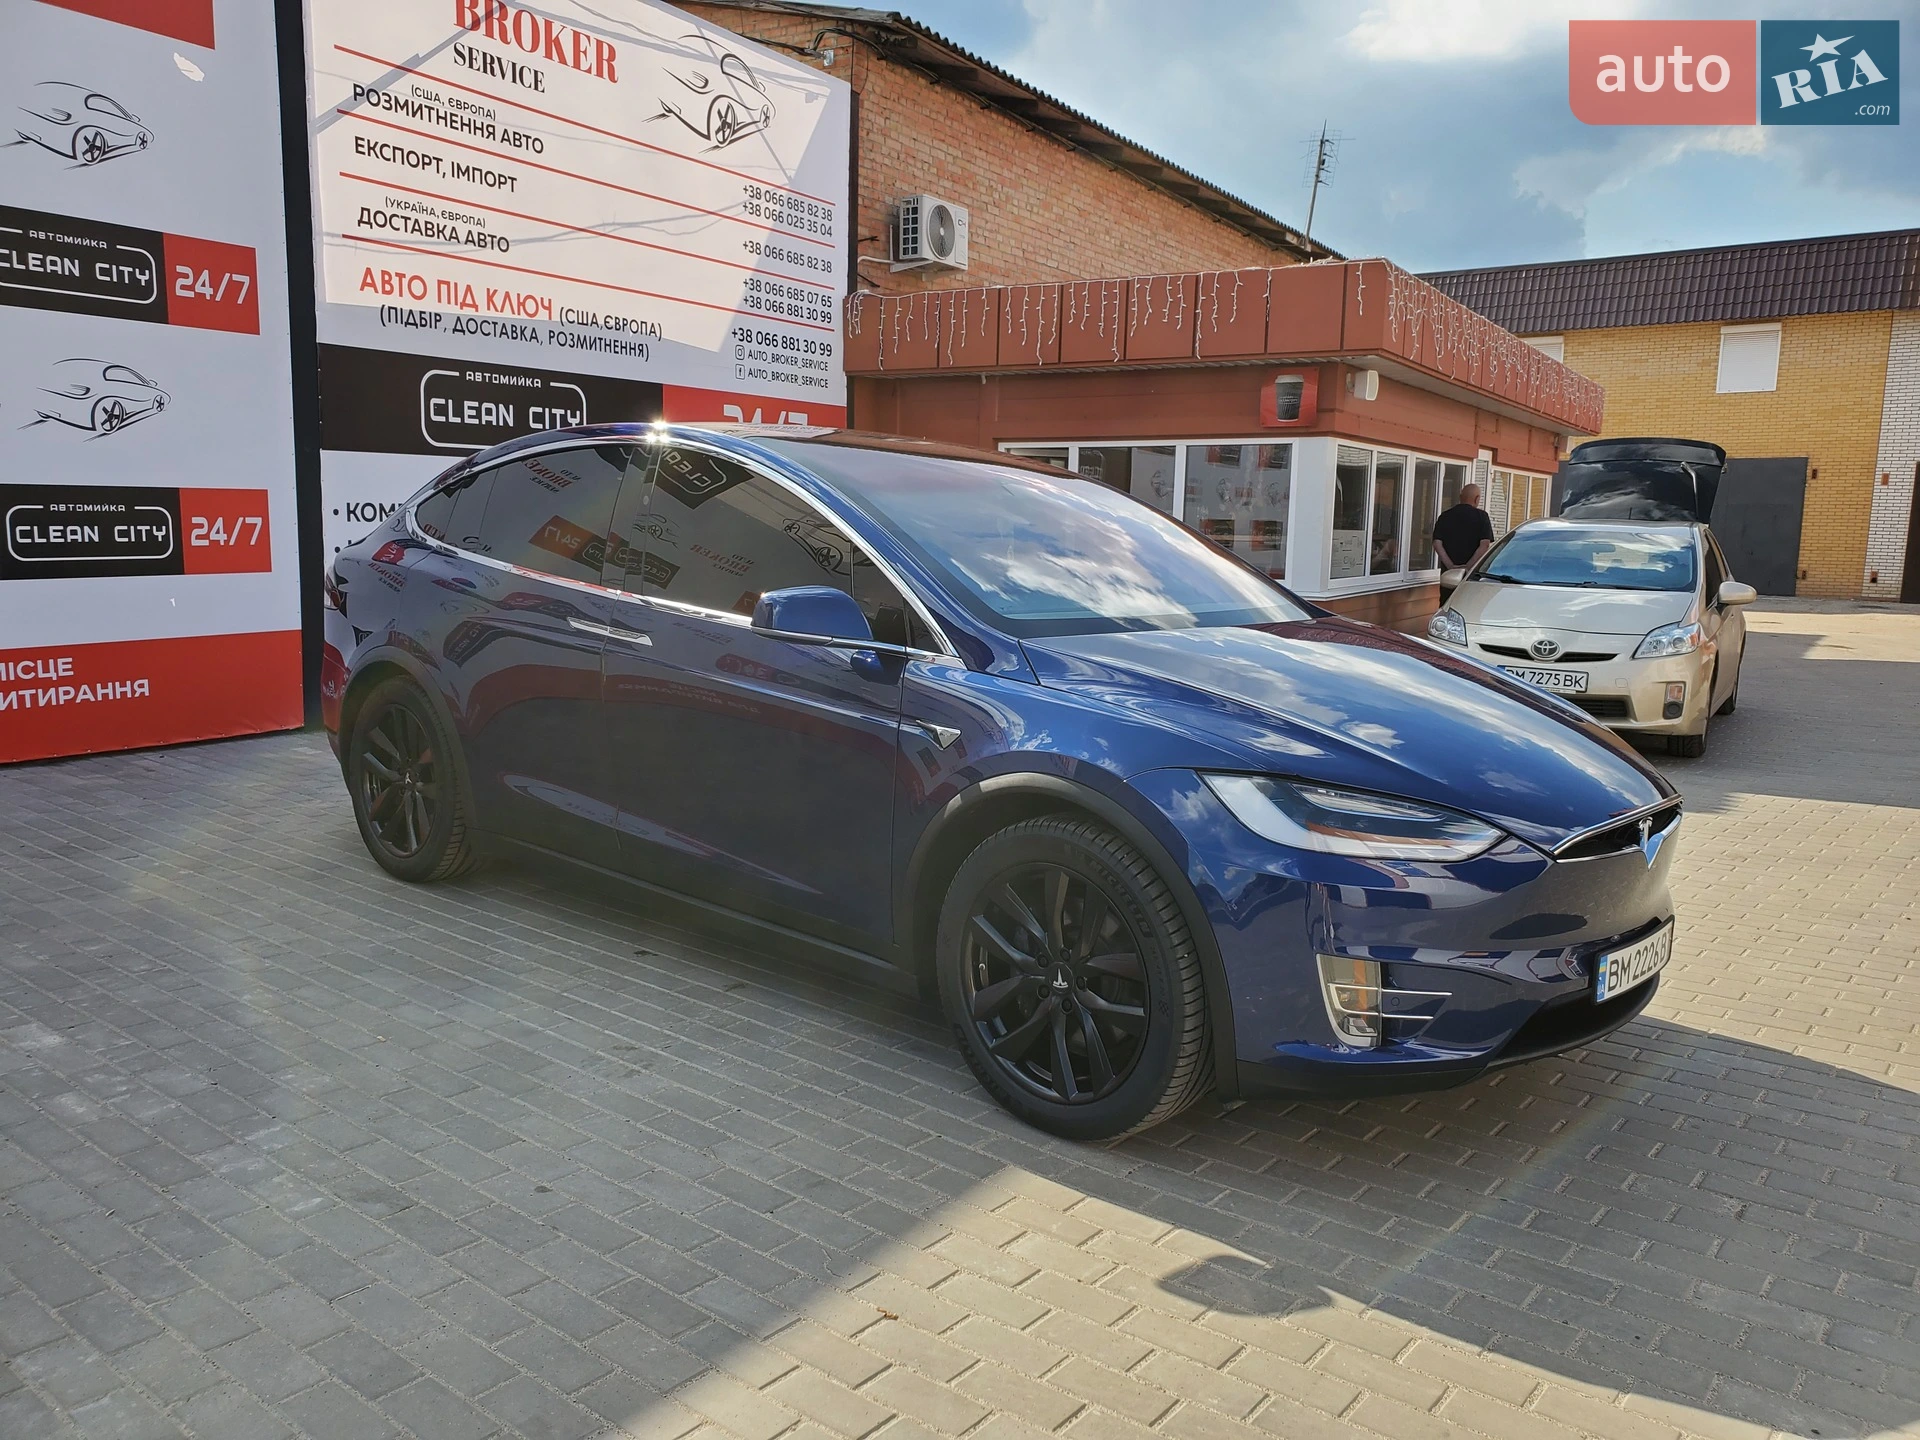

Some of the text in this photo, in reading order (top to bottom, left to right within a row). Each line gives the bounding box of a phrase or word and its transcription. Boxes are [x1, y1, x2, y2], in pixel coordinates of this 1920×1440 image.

[454, 0, 617, 83] BROKER
[454, 42, 545, 93] SERVICE
[353, 83, 544, 154] РОЗМИТНЕННЯ АВТО
[448, 97, 496, 121] ЄВРОПА)
[354, 136, 517, 192] ЕКСПОРТ, ІМПОРТ
[742, 202, 832, 237] +38 066 025 35 04
[743, 185, 833, 221] +38 066 685 82 38
[29, 230, 107, 249] АВТОМИЙКА
[357, 206, 510, 253] ДОСТАВКА АВТО
[0, 248, 149, 286] CLEAN CITY
[742, 240, 832, 273] +38 066 685 82 38
[175, 265, 250, 304] 24/7
[359, 266, 427, 301] АВТО
[437, 279, 479, 313] ПІД
[486, 287, 552, 320] КЛЮЧ
[743, 278, 832, 308] +38 066 685 07 65
[743, 295, 762, 310] +38
[764, 298, 784, 314] 066
[787, 304, 804, 318] 881
[820, 311, 832, 324] 99
[379, 304, 650, 361] (ПІДБІР, ДОСТАВКА, РОЗМИТНЕННЯ)
[731, 327, 832, 358] +38 066 881 30 99
[747, 349, 829, 372] AUTO_BROKER_SERVICE
[466, 371, 542, 388] АВТОМИЙКА
[747, 367, 829, 389] AUTO_BROKER_SERVICE
[430, 397, 581, 430] CLEAN CITY
[50, 503, 126, 512] АВТОМИЙКА
[346, 502, 404, 522] КОМ
[15, 525, 167, 543] CLEAN CITY
[191, 516, 263, 546] 24/7
[1529, 671, 1561, 686] 7275
[1563, 674, 1585, 689] BK
[1608, 928, 1672, 993] BM 2226 B
